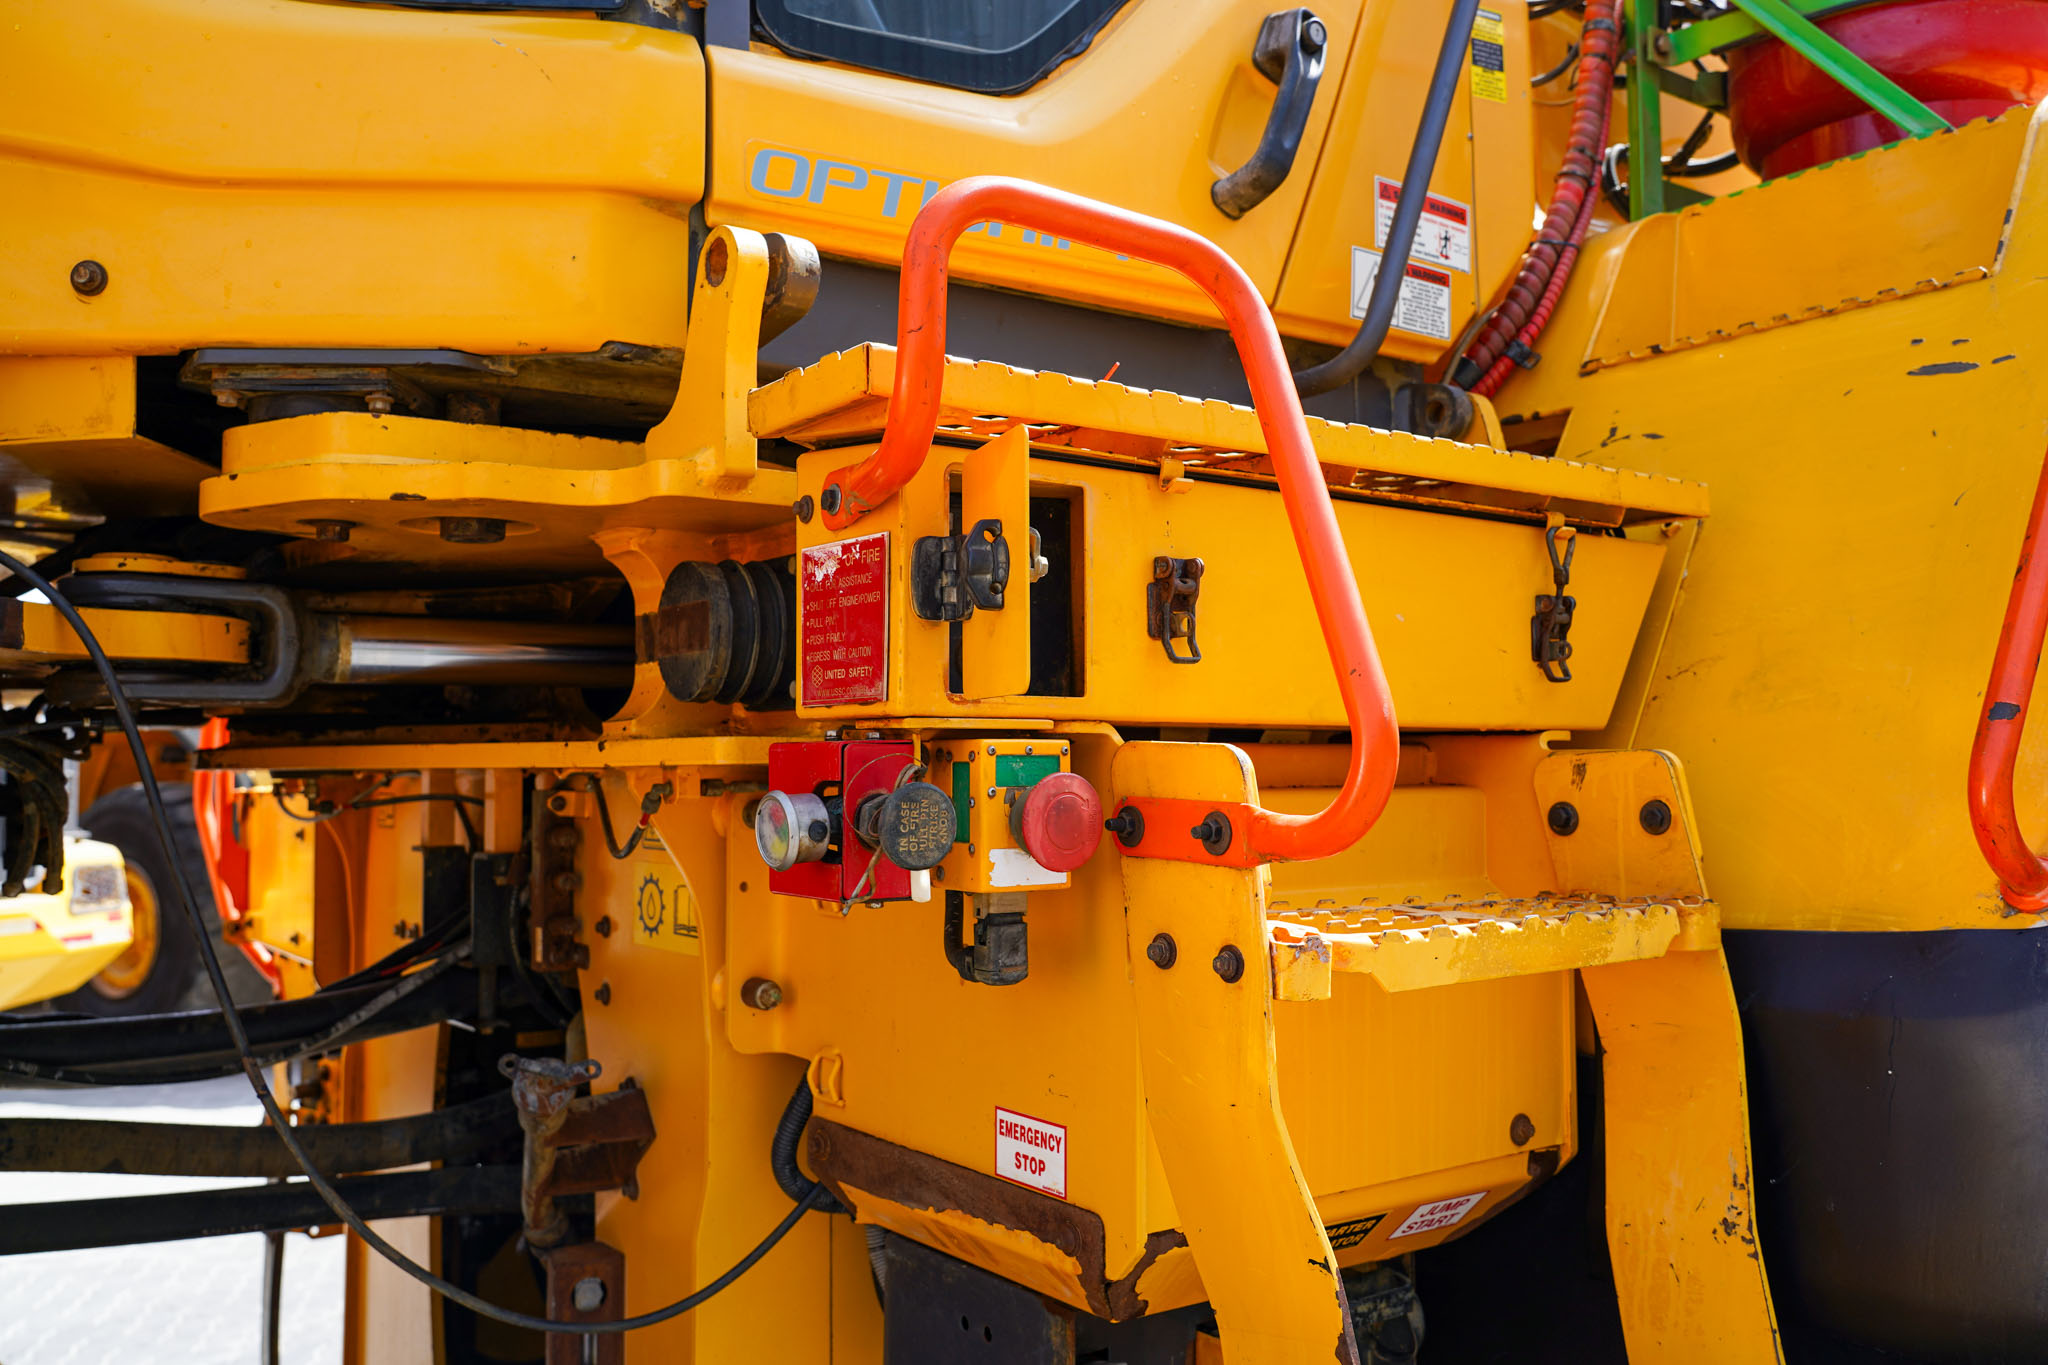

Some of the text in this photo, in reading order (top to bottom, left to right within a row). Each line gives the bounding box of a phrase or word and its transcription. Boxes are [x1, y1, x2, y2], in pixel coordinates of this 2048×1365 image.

[806, 560, 815, 575] IN
[845, 552, 857, 567] OF
[861, 547, 881, 564] FIRE
[838, 572, 873, 588] ASSISTANCE
[810, 618, 824, 628] PULL
[810, 632, 846, 645] PUSH FIRMLY
[809, 646, 872, 662] EGRESS WITH CAUTION
[824, 666, 874, 680] UNITED SAFETY
[920, 799, 929, 820] PIN
[899, 801, 910, 852] IN CASE
[909, 802, 920, 852] OF FIRE
[928, 804, 939, 849] STRIKE
[999, 1118, 1062, 1154] EMERGENCY
[1014, 1151, 1046, 1176] STOP
[1419, 1198, 1471, 1218] JUMP
[1401, 1212, 1461, 1233] START
